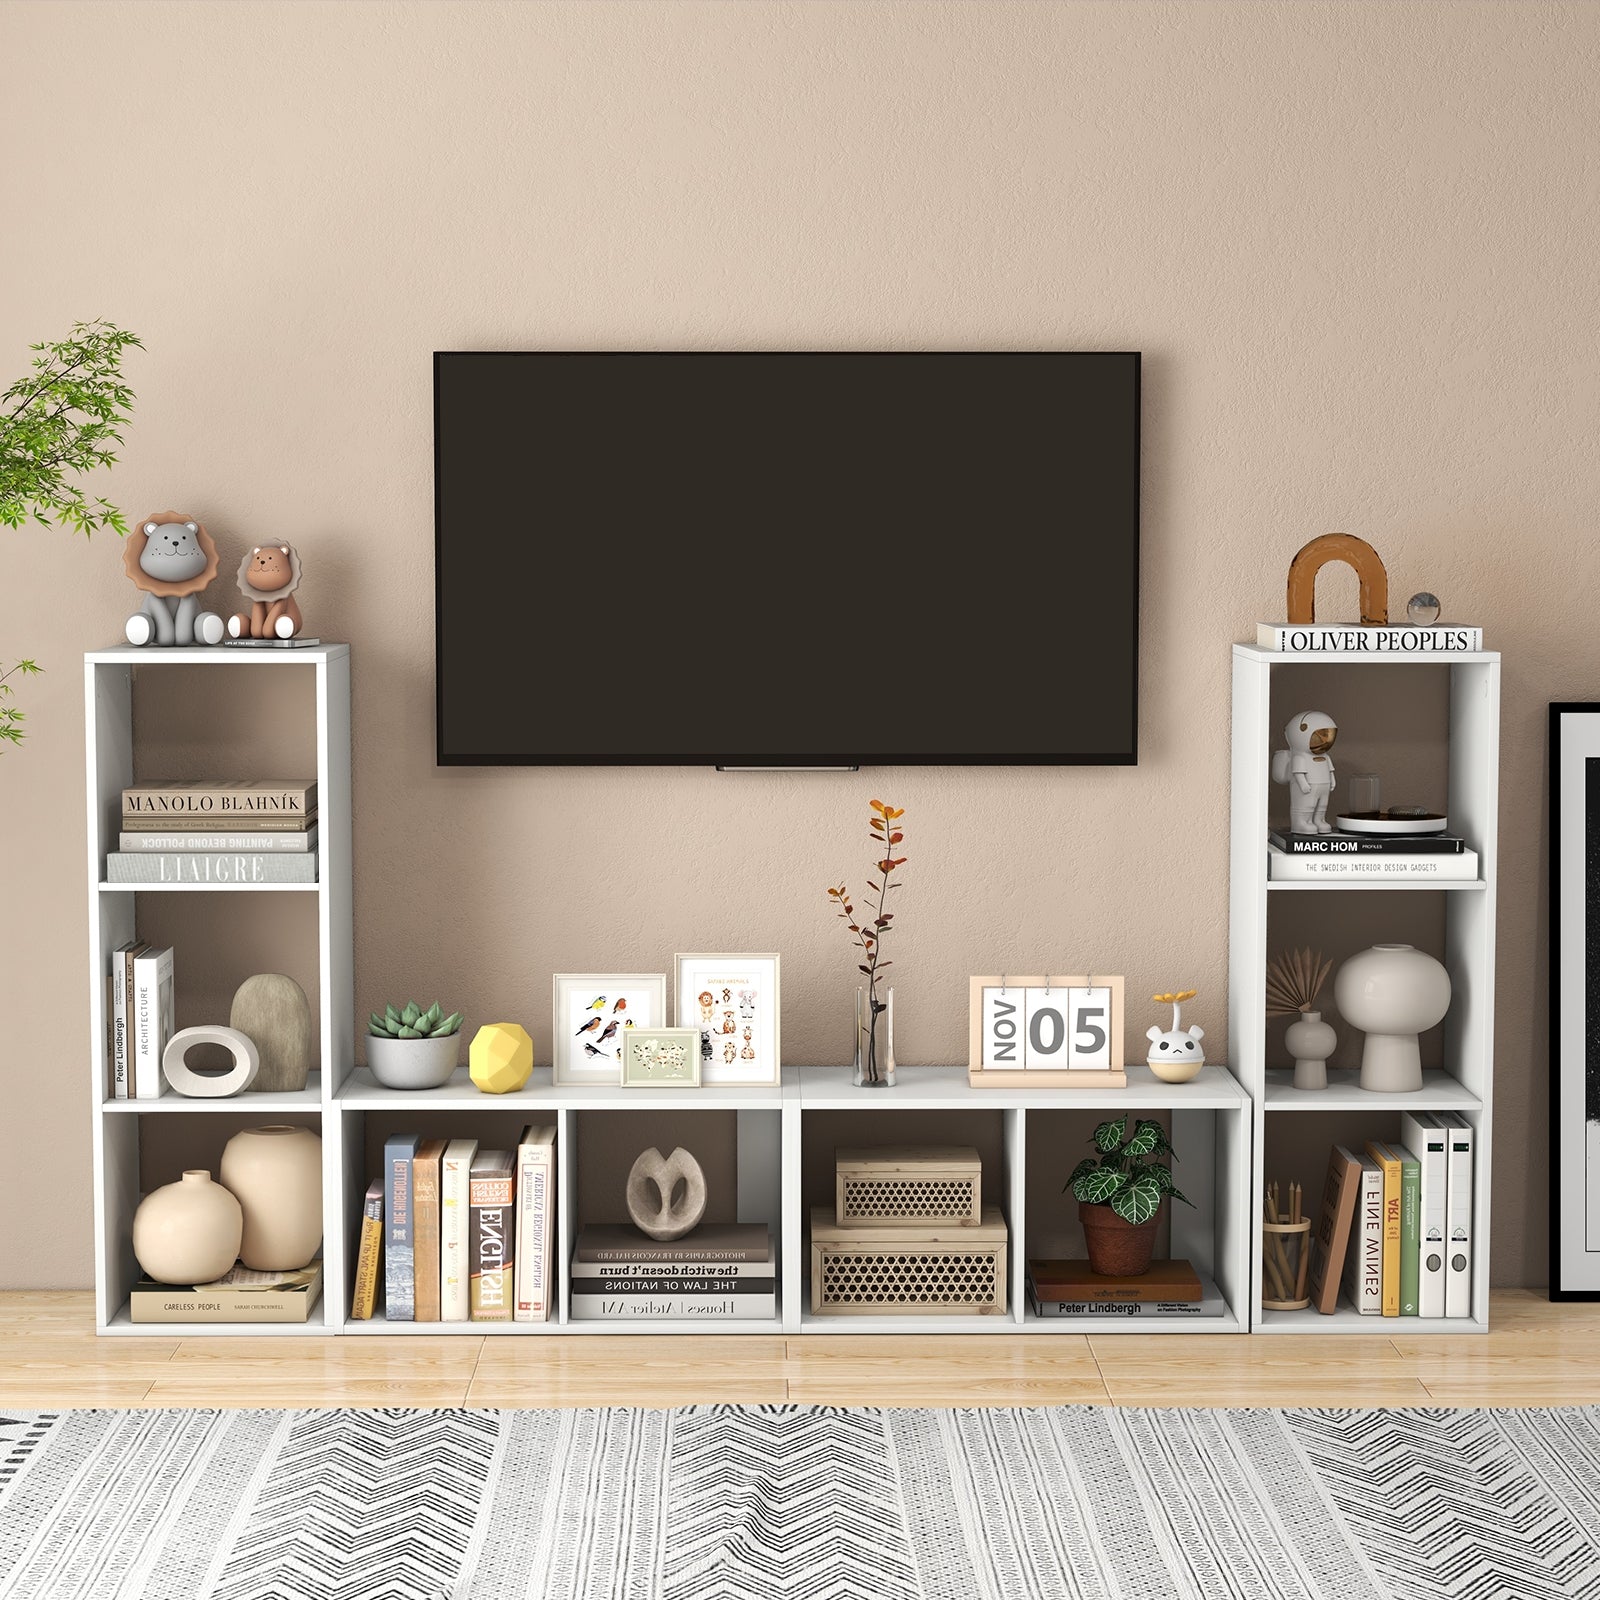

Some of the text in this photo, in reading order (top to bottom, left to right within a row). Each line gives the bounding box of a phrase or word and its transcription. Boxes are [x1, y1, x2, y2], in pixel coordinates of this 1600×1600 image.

[1290, 631, 1369, 651] OLIVER
[1376, 631, 1468, 651] PEOPLES
[128, 793, 300, 811] MANOLO BLAHNÍK
[142, 838, 184, 848] POLLOCK
[188, 838, 226, 848] BEYOND
[230, 838, 272, 848] PAINTING
[1294, 842, 1358, 852] MARC HOM
[160, 857, 264, 880] LIAIGRE
[994, 1000, 1016, 1060] NOV
[116, 1018, 124, 1059] Lindbergh
[1059, 1303, 1141, 1315] Peter Lindbergh
